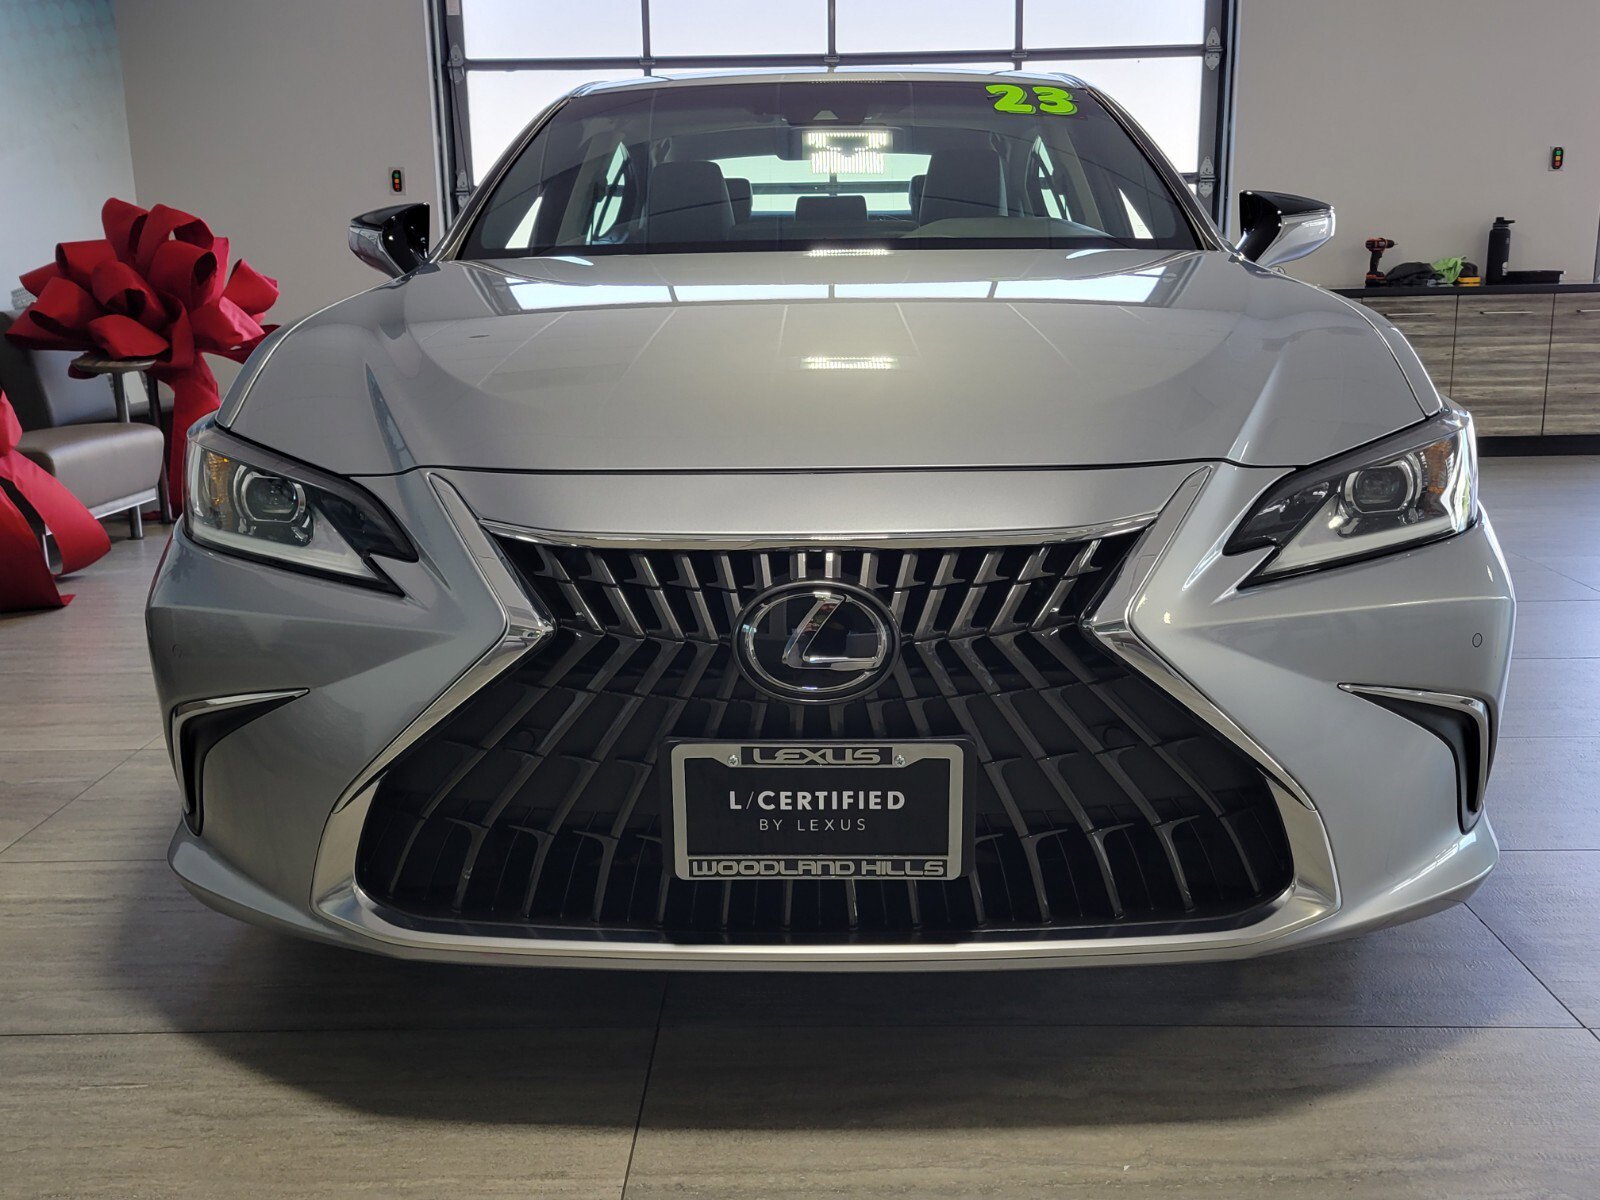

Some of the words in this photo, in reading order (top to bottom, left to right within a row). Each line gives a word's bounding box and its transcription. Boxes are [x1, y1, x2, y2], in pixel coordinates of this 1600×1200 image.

[985, 84, 1078, 115] 23
[752, 748, 881, 765] LEXUS
[759, 818, 783, 831] BY
[797, 818, 866, 831] LEXUS
[692, 860, 856, 876] WOODLAND
[861, 860, 944, 875] HILLS
